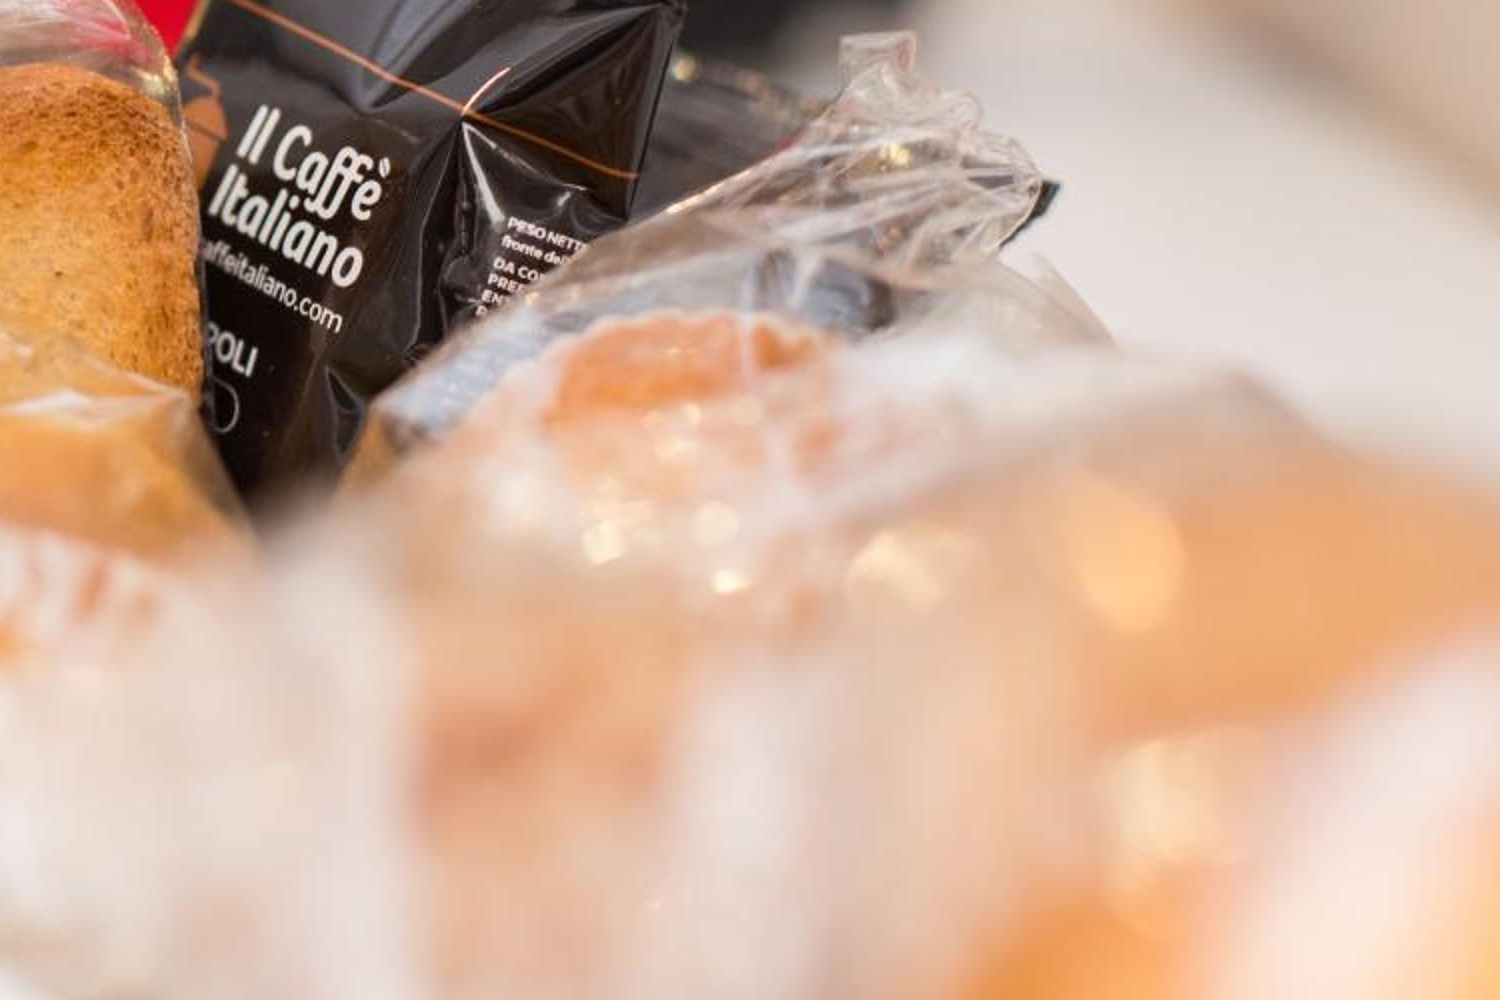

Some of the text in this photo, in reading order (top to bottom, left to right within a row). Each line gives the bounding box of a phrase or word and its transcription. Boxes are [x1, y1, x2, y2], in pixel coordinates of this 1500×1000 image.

[237, 105, 281, 165] Il
[207, 164, 363, 288] Italiano
[501, 234, 543, 260] fronte
[507, 216, 546, 240] PESO
[202, 239, 343, 334] affeitaliano.com
[493, 256, 515, 275] DA
